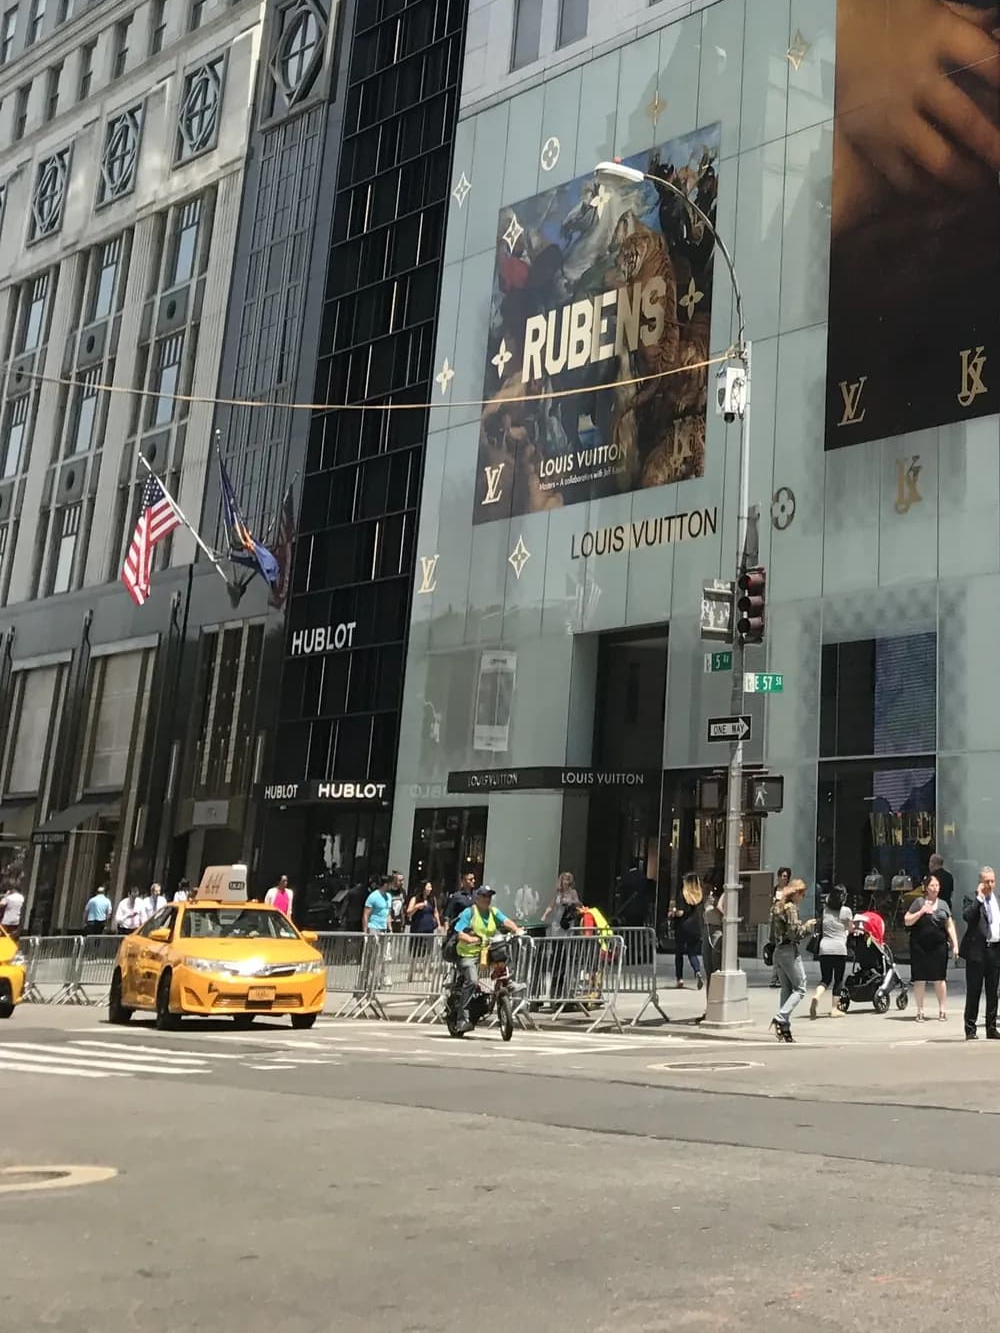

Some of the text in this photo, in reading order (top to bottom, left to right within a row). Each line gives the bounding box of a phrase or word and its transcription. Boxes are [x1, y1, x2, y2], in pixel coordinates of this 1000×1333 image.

[521, 275, 667, 384] RUBENS
[539, 443, 628, 479] LOUIS VUITTON
[571, 506, 718, 560] LOUIS VUITTON
[291, 621, 357, 656] HUBLOT
[715, 654, 721, 669] 5
[755, 675, 760, 690] E
[762, 675, 773, 690] 57
[713, 720, 745, 735] ONE WAY
[561, 772, 645, 785] LOUIS VUITTON
[264, 783, 298, 800] HUBLOT
[318, 783, 386, 799] HUBLOT
